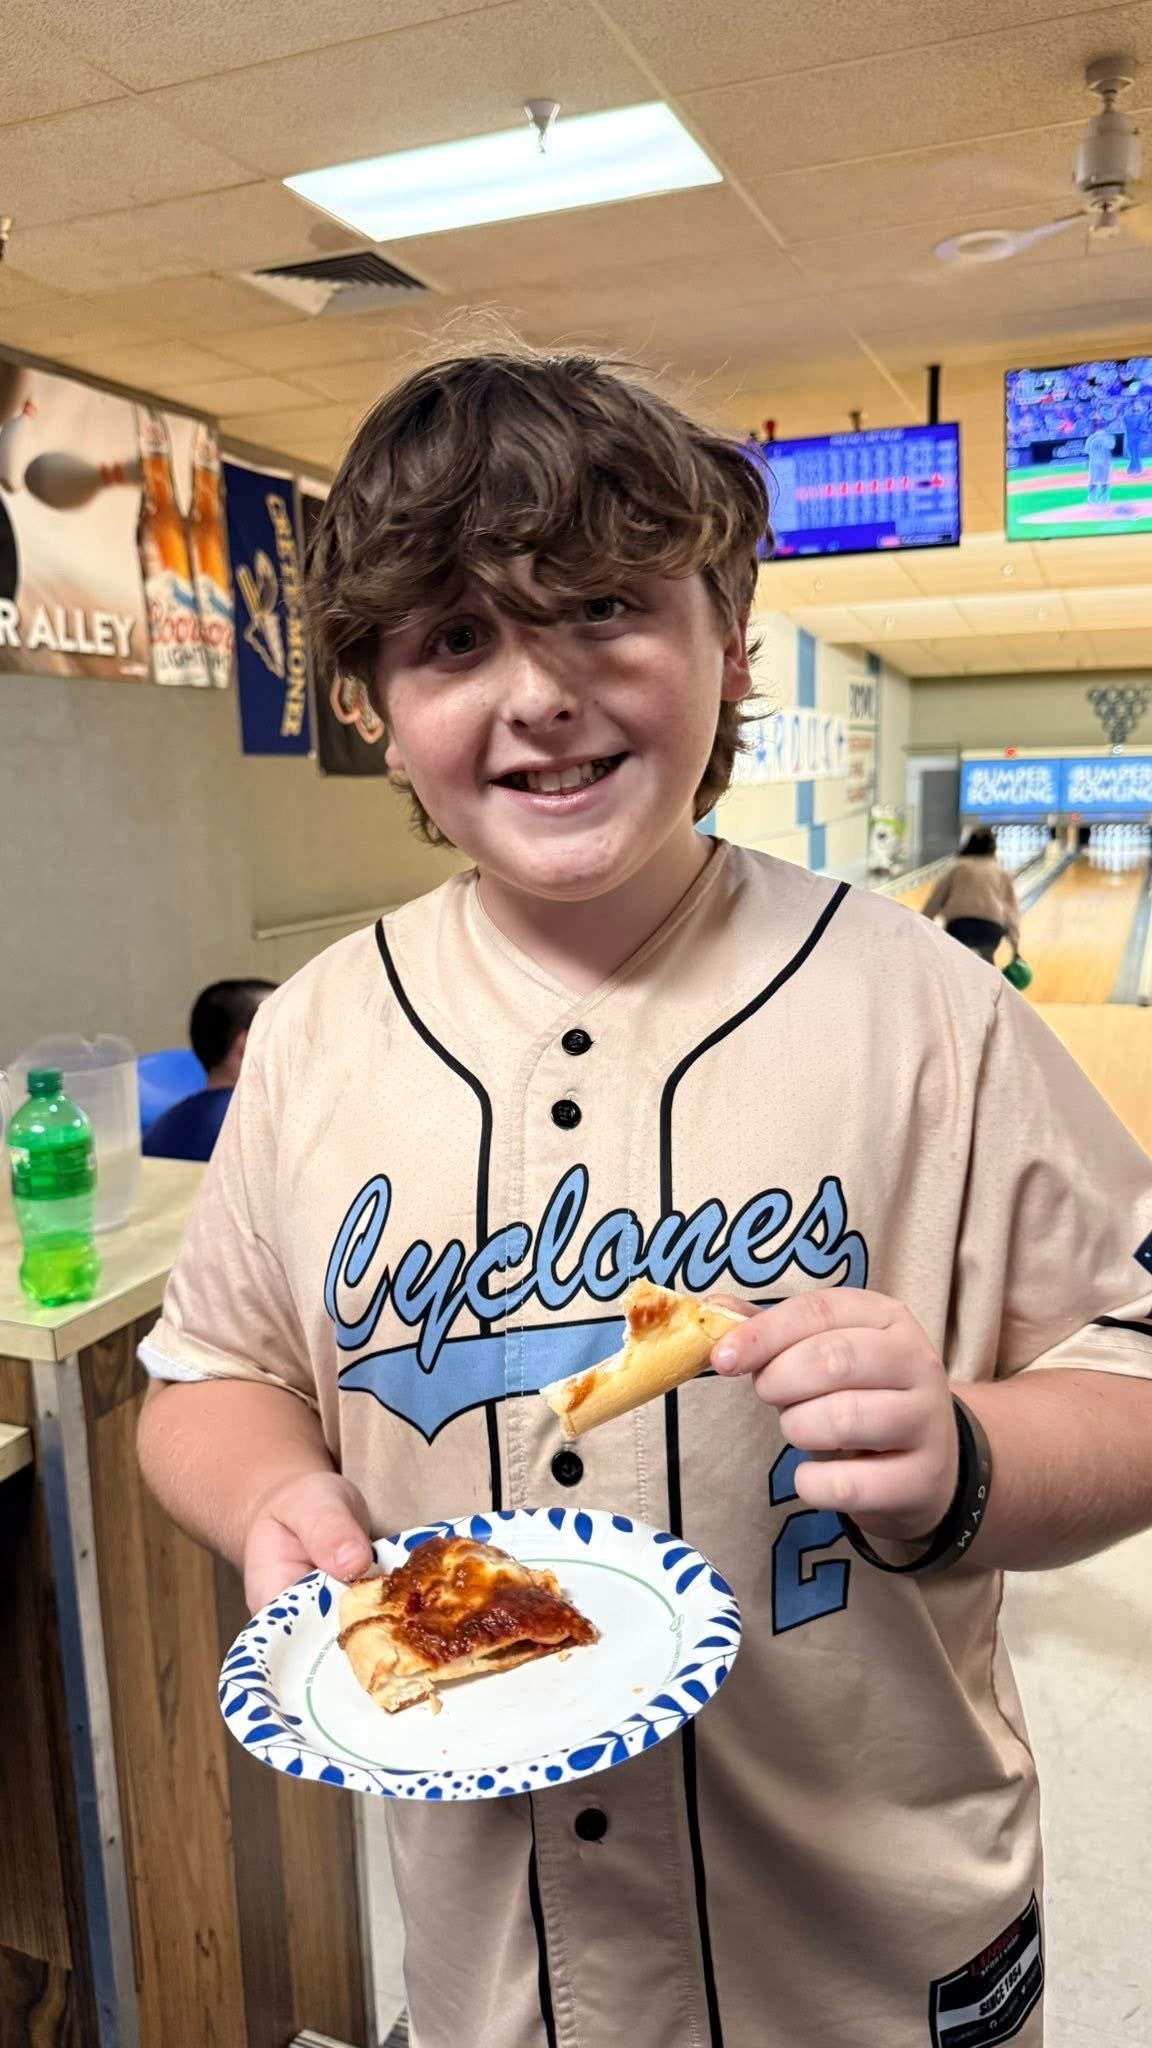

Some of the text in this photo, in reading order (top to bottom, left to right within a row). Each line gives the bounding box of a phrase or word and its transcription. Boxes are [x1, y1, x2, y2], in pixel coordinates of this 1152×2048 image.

[28, 604, 135, 658] ALLEY
[966, 782, 1056, 805] BOWLING
[968, 765, 1052, 786] BUMPER
[324, 1163, 867, 1374] Cyclones
[979, 1981, 1006, 2016] SINCE
[1003, 1960, 1022, 1993] 1954
